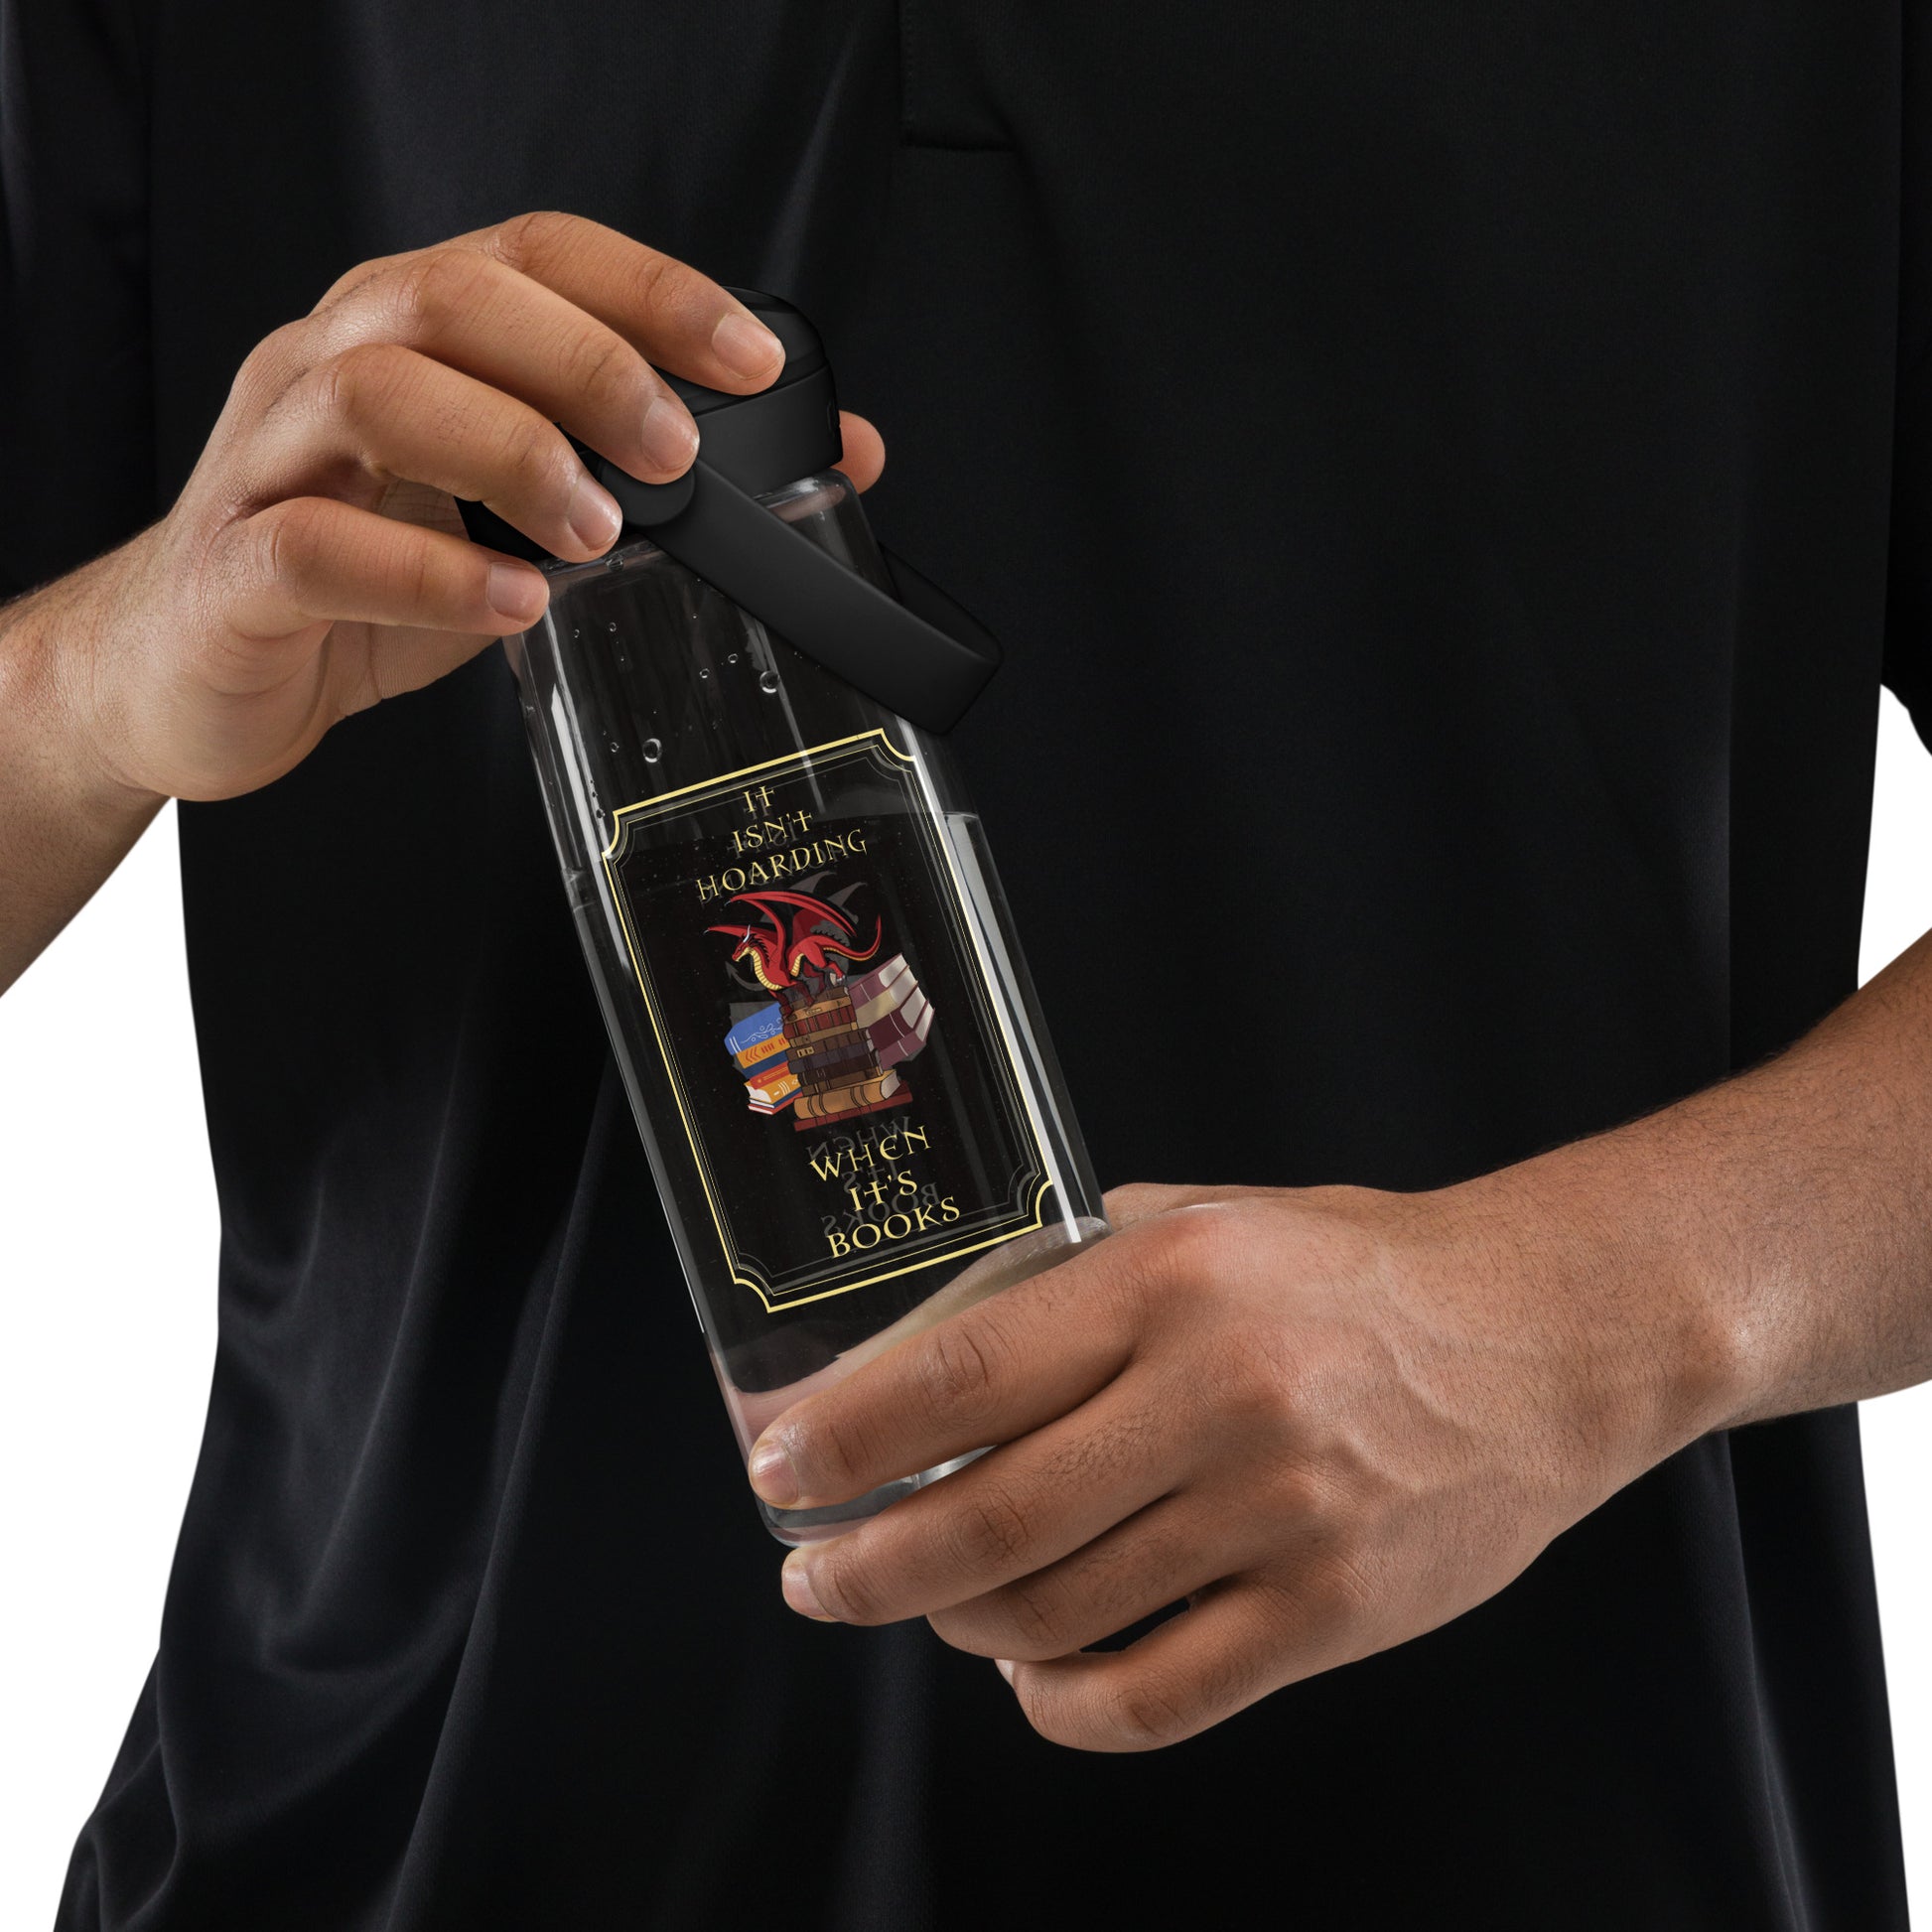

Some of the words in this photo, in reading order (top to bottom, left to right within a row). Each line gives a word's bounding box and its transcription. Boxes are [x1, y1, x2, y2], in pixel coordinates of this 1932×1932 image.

[695, 828, 868, 900] HOARDING
[810, 1125, 931, 1181] WHEN
[849, 1170, 917, 1211] IT'S
[827, 1196, 960, 1258] BOOKS
